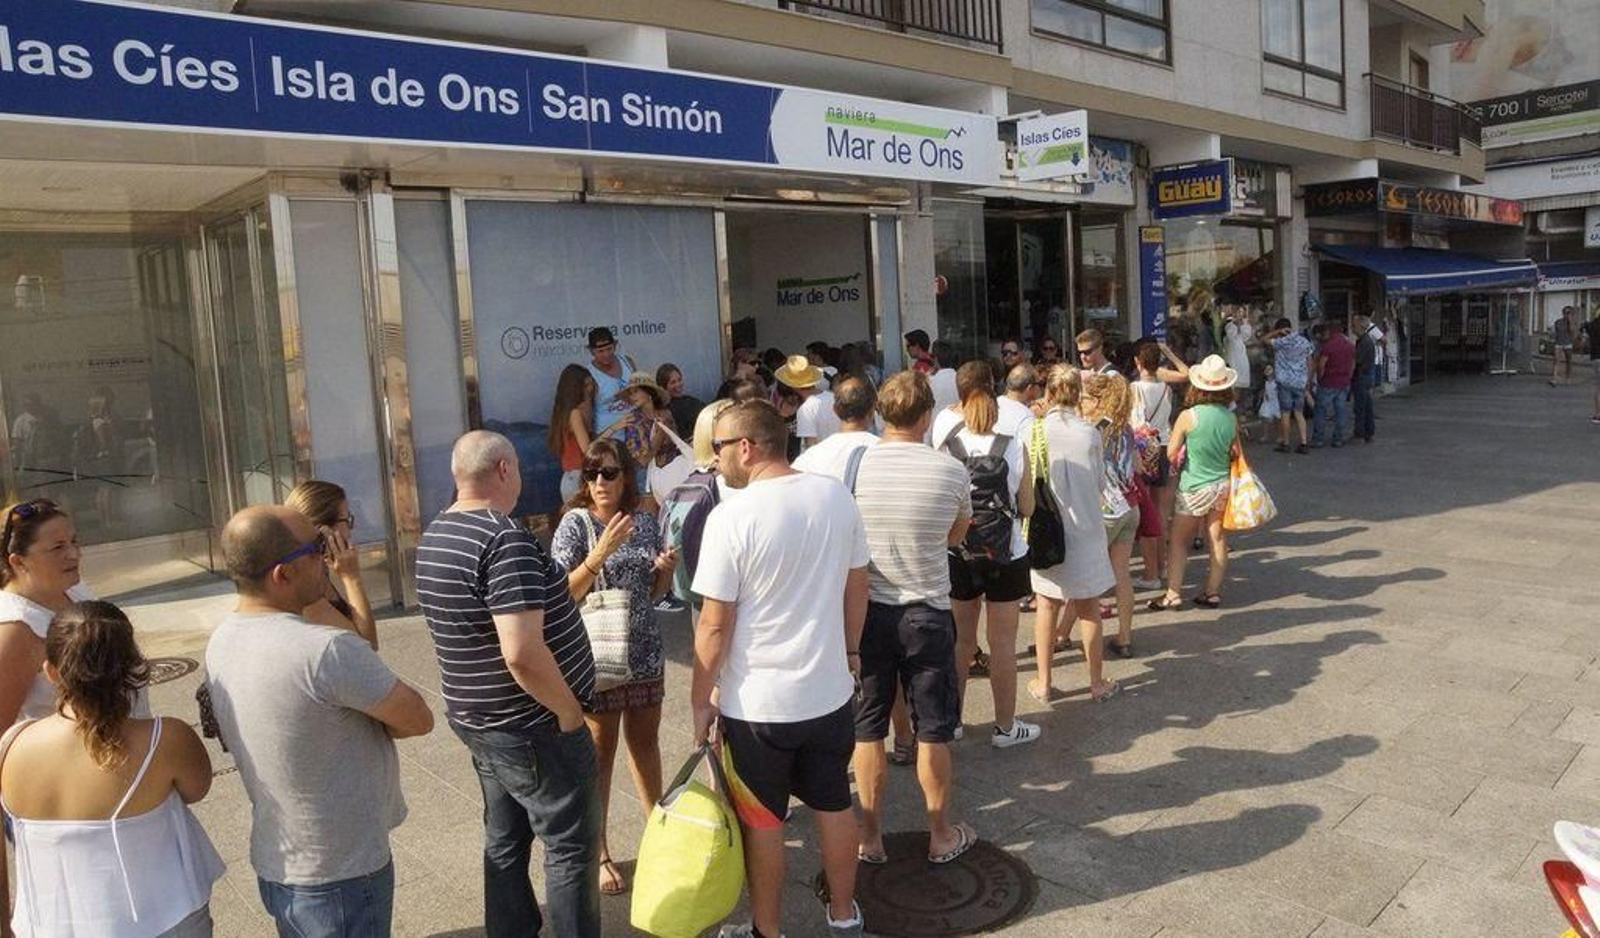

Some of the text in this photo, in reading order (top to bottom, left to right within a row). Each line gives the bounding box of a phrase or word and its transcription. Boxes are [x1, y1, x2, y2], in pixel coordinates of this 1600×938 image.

[114, 40, 239, 92] Cíes
[272, 56, 355, 102] Isla
[371, 69, 425, 108] de
[439, 74, 520, 115] Ons
[543, 84, 611, 123] San
[623, 93, 722, 134] Simón
[827, 106, 877, 124] naviera
[1489, 100, 1519, 119] 700
[1020, 126, 1082, 146] Islas Cíes
[827, 126, 964, 170] Mar de Ons
[776, 286, 860, 307] Mar de Ons
[533, 325, 590, 341] Reserv
[623, 319, 667, 336] online
